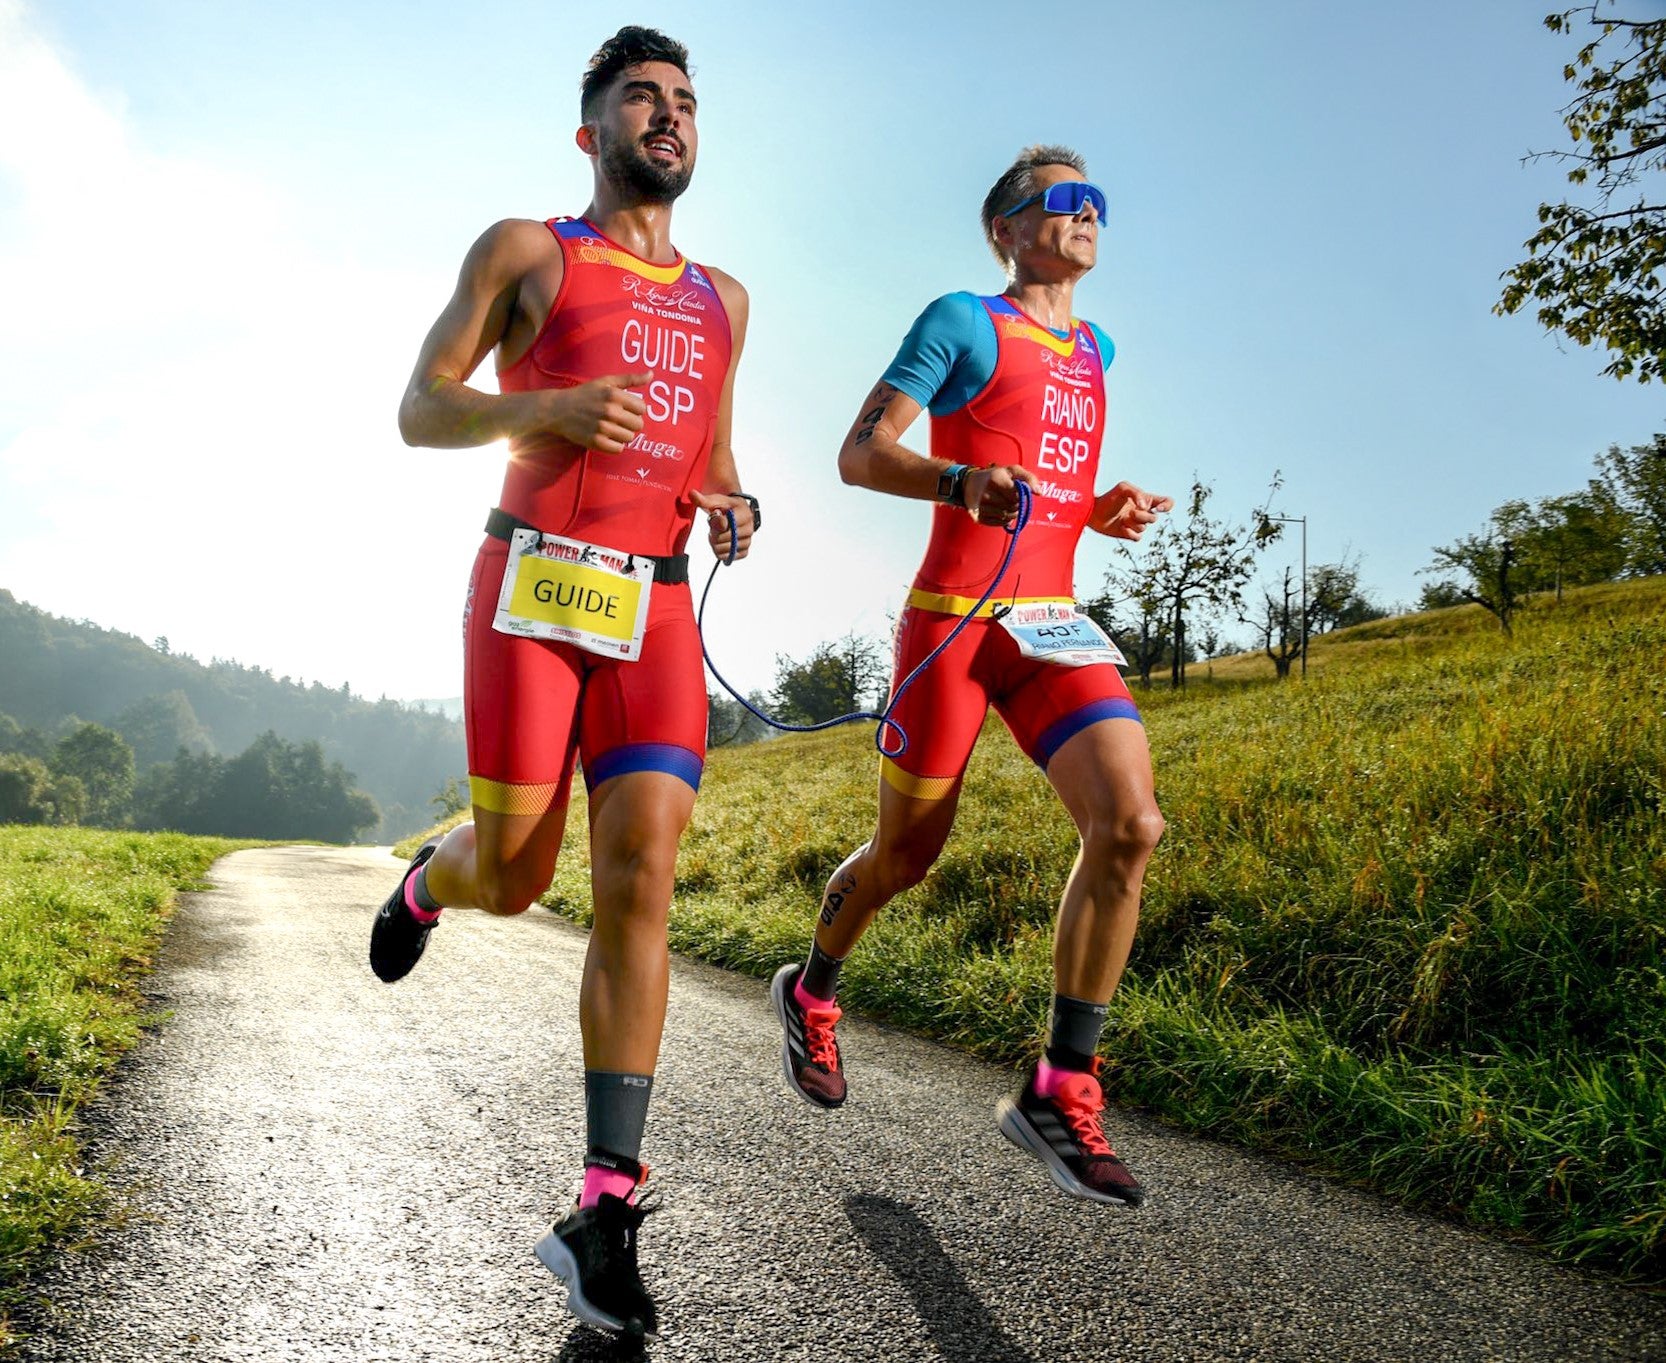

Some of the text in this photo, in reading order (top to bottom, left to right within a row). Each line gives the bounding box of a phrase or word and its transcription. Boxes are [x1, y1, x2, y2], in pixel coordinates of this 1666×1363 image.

[656, 308, 703, 326] TONDONIA
[621, 319, 706, 380] GUIDE
[623, 380, 695, 426] SP
[1041, 384, 1097, 433] RIAÑO
[1037, 431, 1089, 475] ESP
[1039, 480, 1083, 504] Muga
[539, 540, 580, 562] POWER
[533, 578, 621, 620] GUIDE
